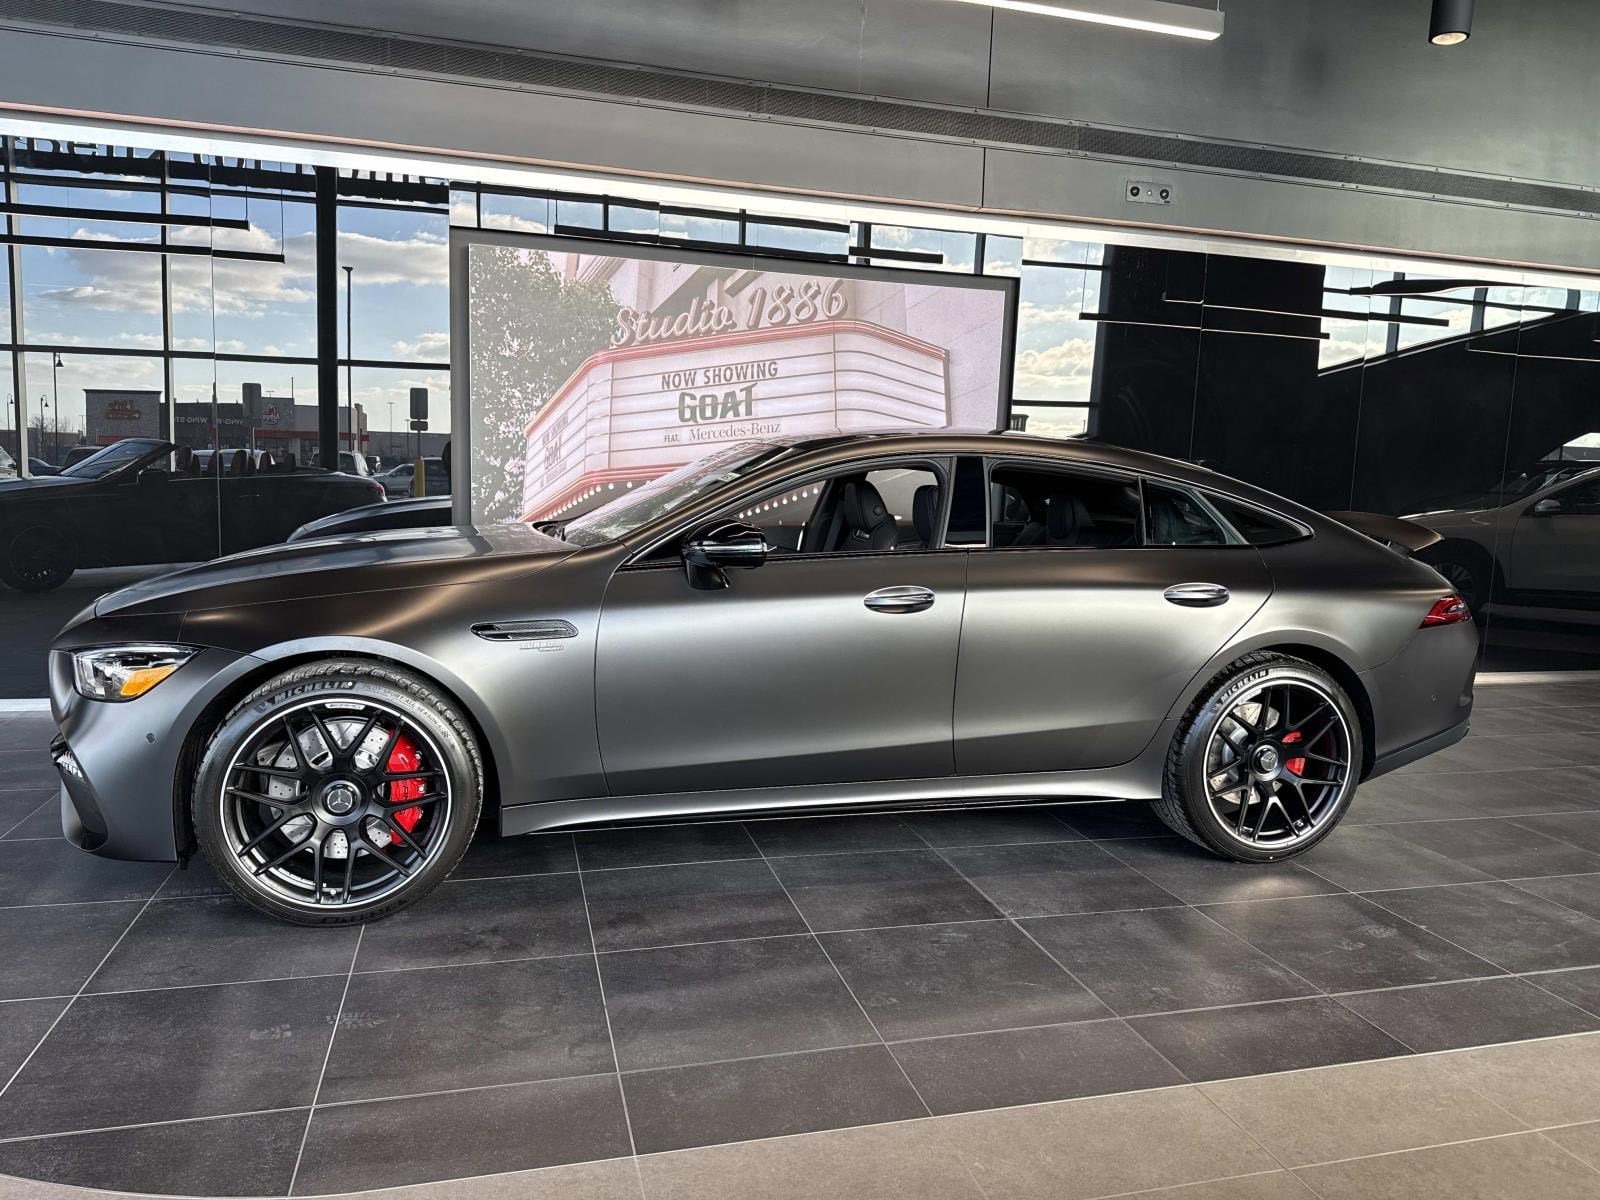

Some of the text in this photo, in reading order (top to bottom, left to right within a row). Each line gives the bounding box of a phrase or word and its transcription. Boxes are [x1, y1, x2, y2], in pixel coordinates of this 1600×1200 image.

[610, 278, 848, 348] Studio 1886
[661, 361, 778, 390] NOW SHOWING
[678, 382, 758, 424] GOAT
[664, 422, 781, 443] FEAT. Mercedes-Benz
[275, 681, 354, 704] MICHELIN
[405, 698, 416, 707] ALL
[1220, 670, 1267, 703] MICHELIN
